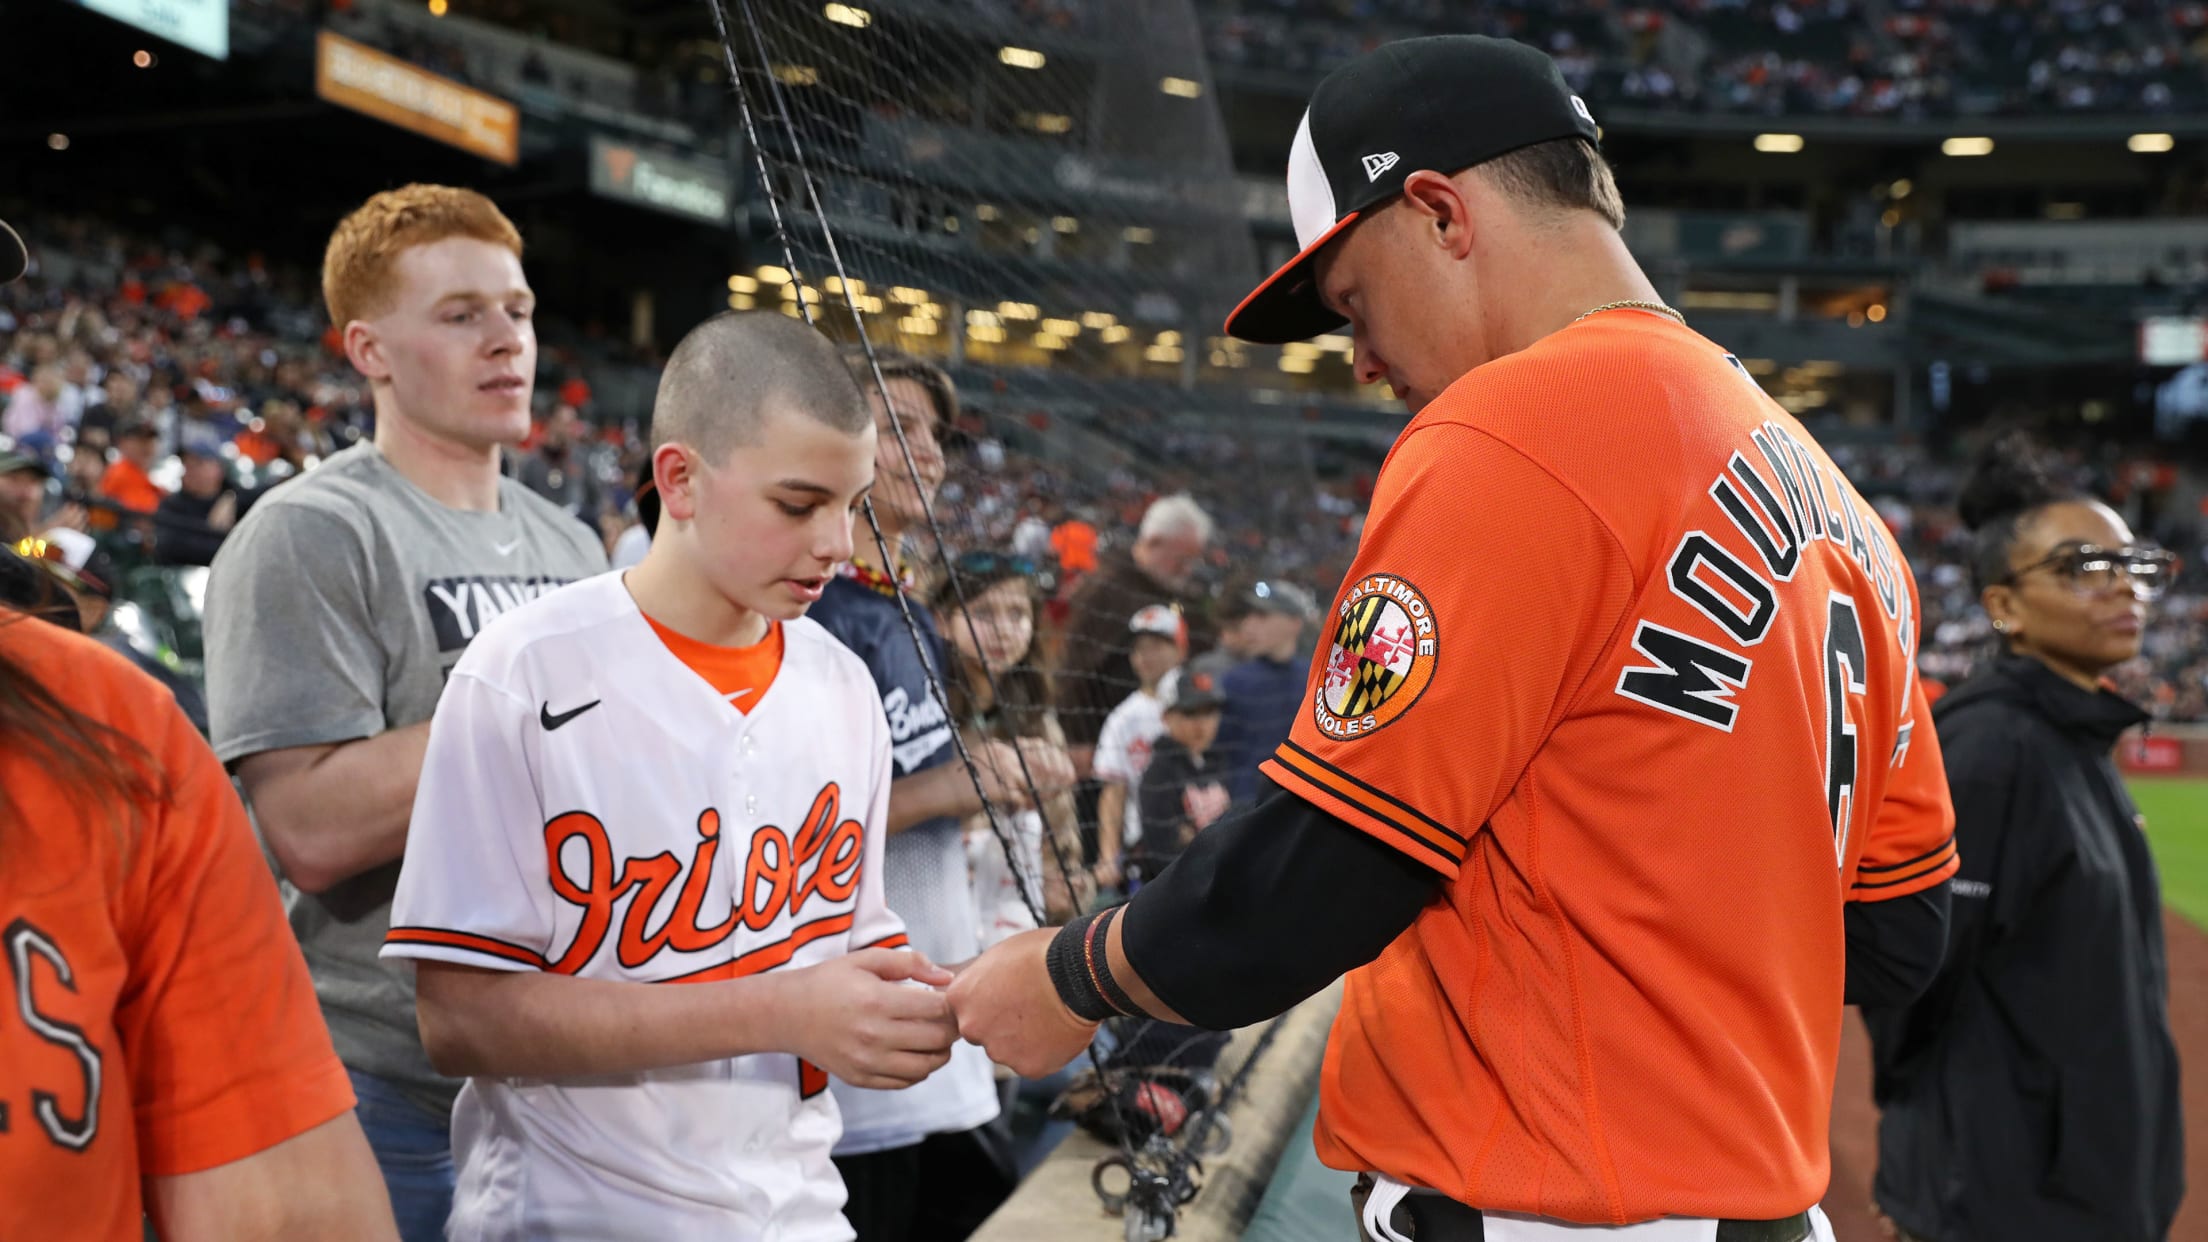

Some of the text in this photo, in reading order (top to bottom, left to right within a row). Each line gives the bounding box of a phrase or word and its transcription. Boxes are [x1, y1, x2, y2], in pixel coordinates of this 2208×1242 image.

[1339, 576, 1435, 657] BALTIMORE
[1316, 686, 1377, 736] ORIOLES
[1823, 589, 1867, 876] 6
[544, 781, 864, 977] Oriole
